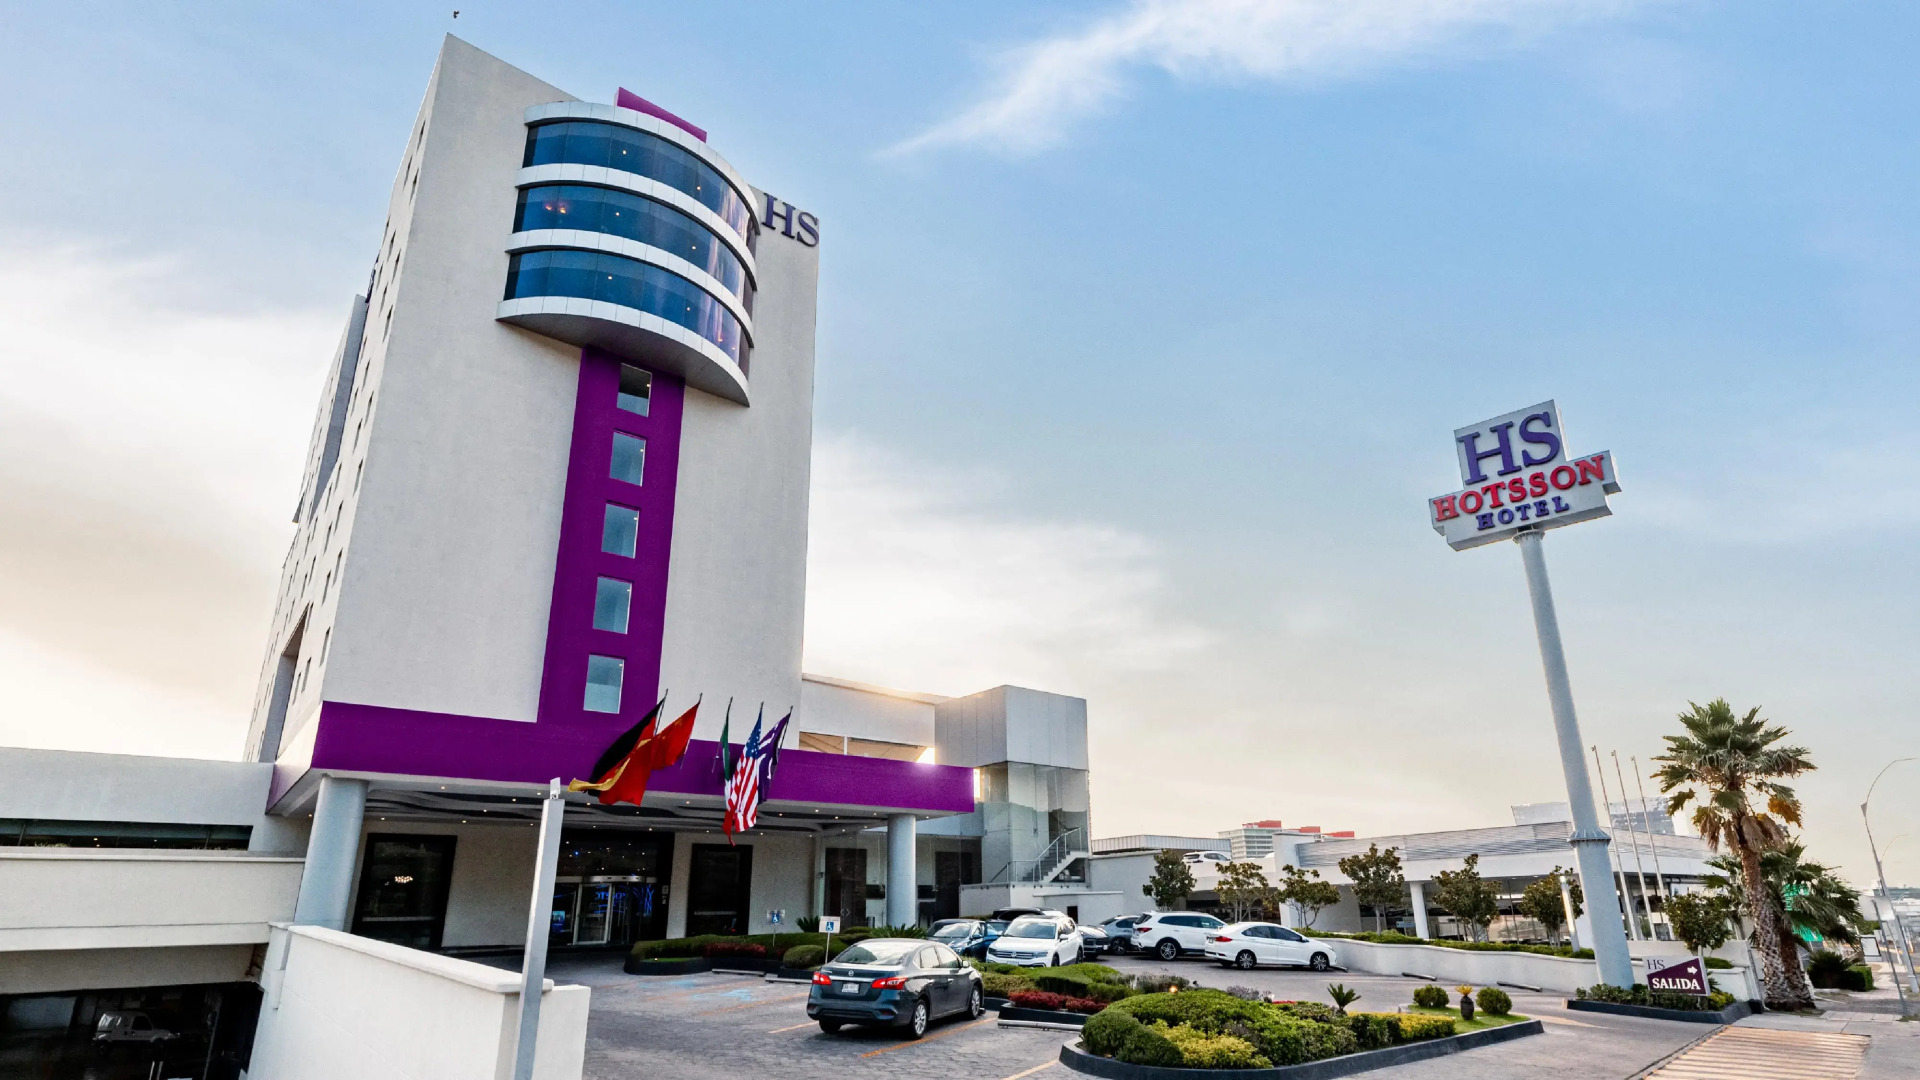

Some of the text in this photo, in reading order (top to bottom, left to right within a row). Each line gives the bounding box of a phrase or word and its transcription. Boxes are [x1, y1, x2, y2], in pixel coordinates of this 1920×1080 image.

[761, 192, 820, 248] HS
[1456, 411, 1561, 486] HS
[1432, 454, 1605, 522] HOTSSON
[1475, 495, 1570, 531] HOTEL
[1646, 959, 1666, 970] HS
[1651, 977, 1702, 990] SALIDA
